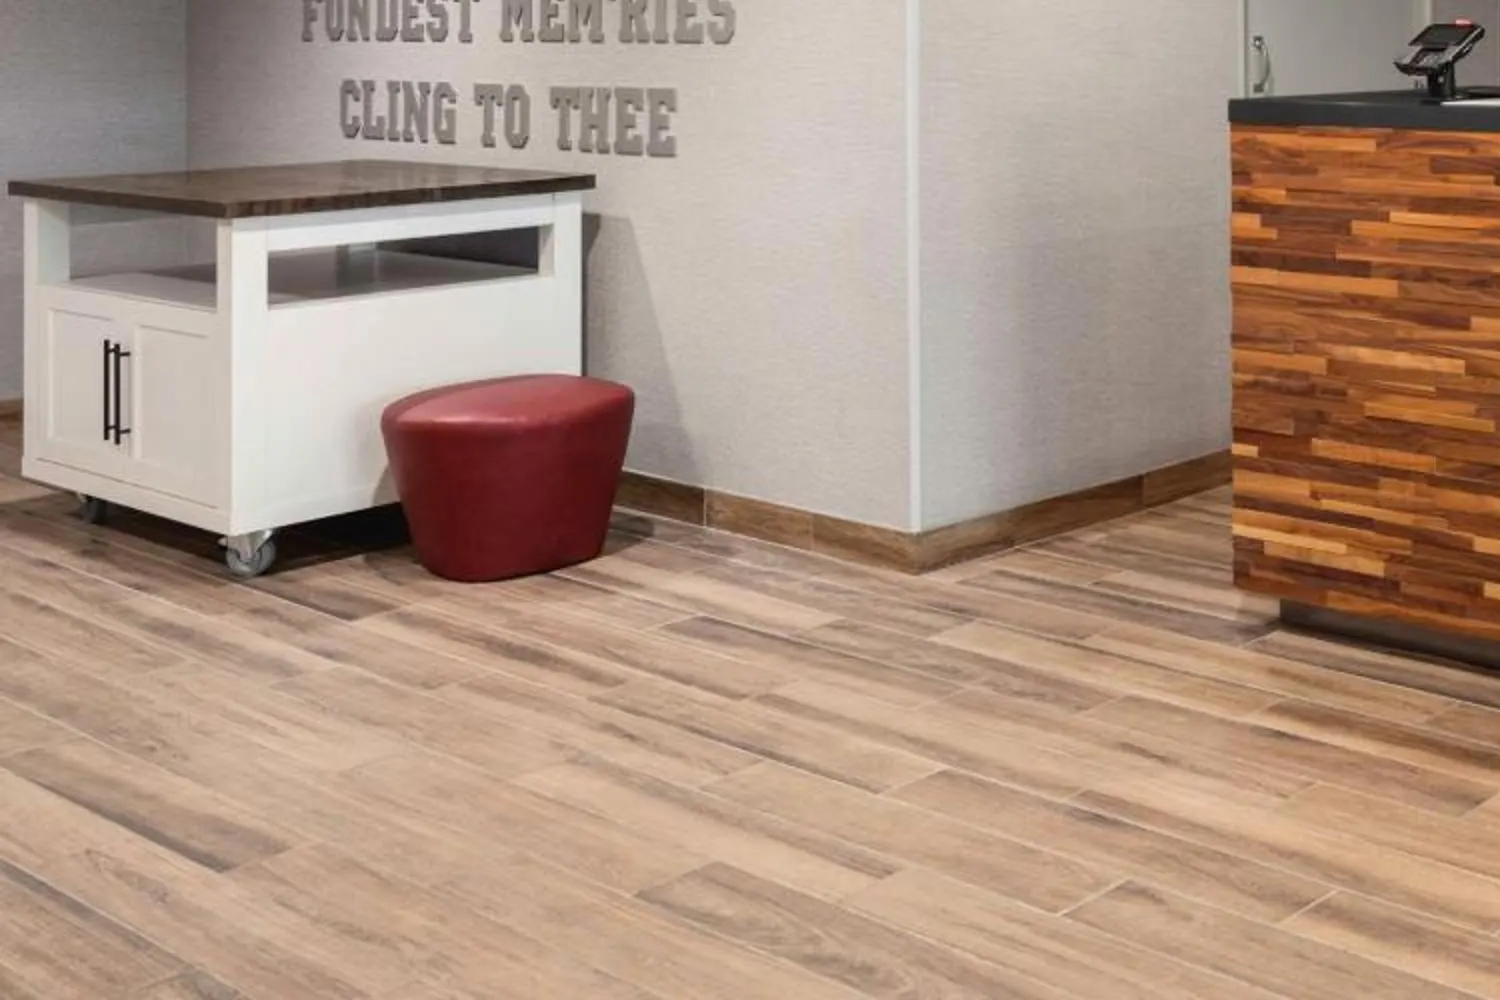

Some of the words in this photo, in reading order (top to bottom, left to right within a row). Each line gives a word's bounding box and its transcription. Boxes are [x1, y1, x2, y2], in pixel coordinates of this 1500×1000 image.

[339, 78, 457, 144] CLING
[474, 82, 531, 149] TO
[549, 85, 678, 157] THEE
